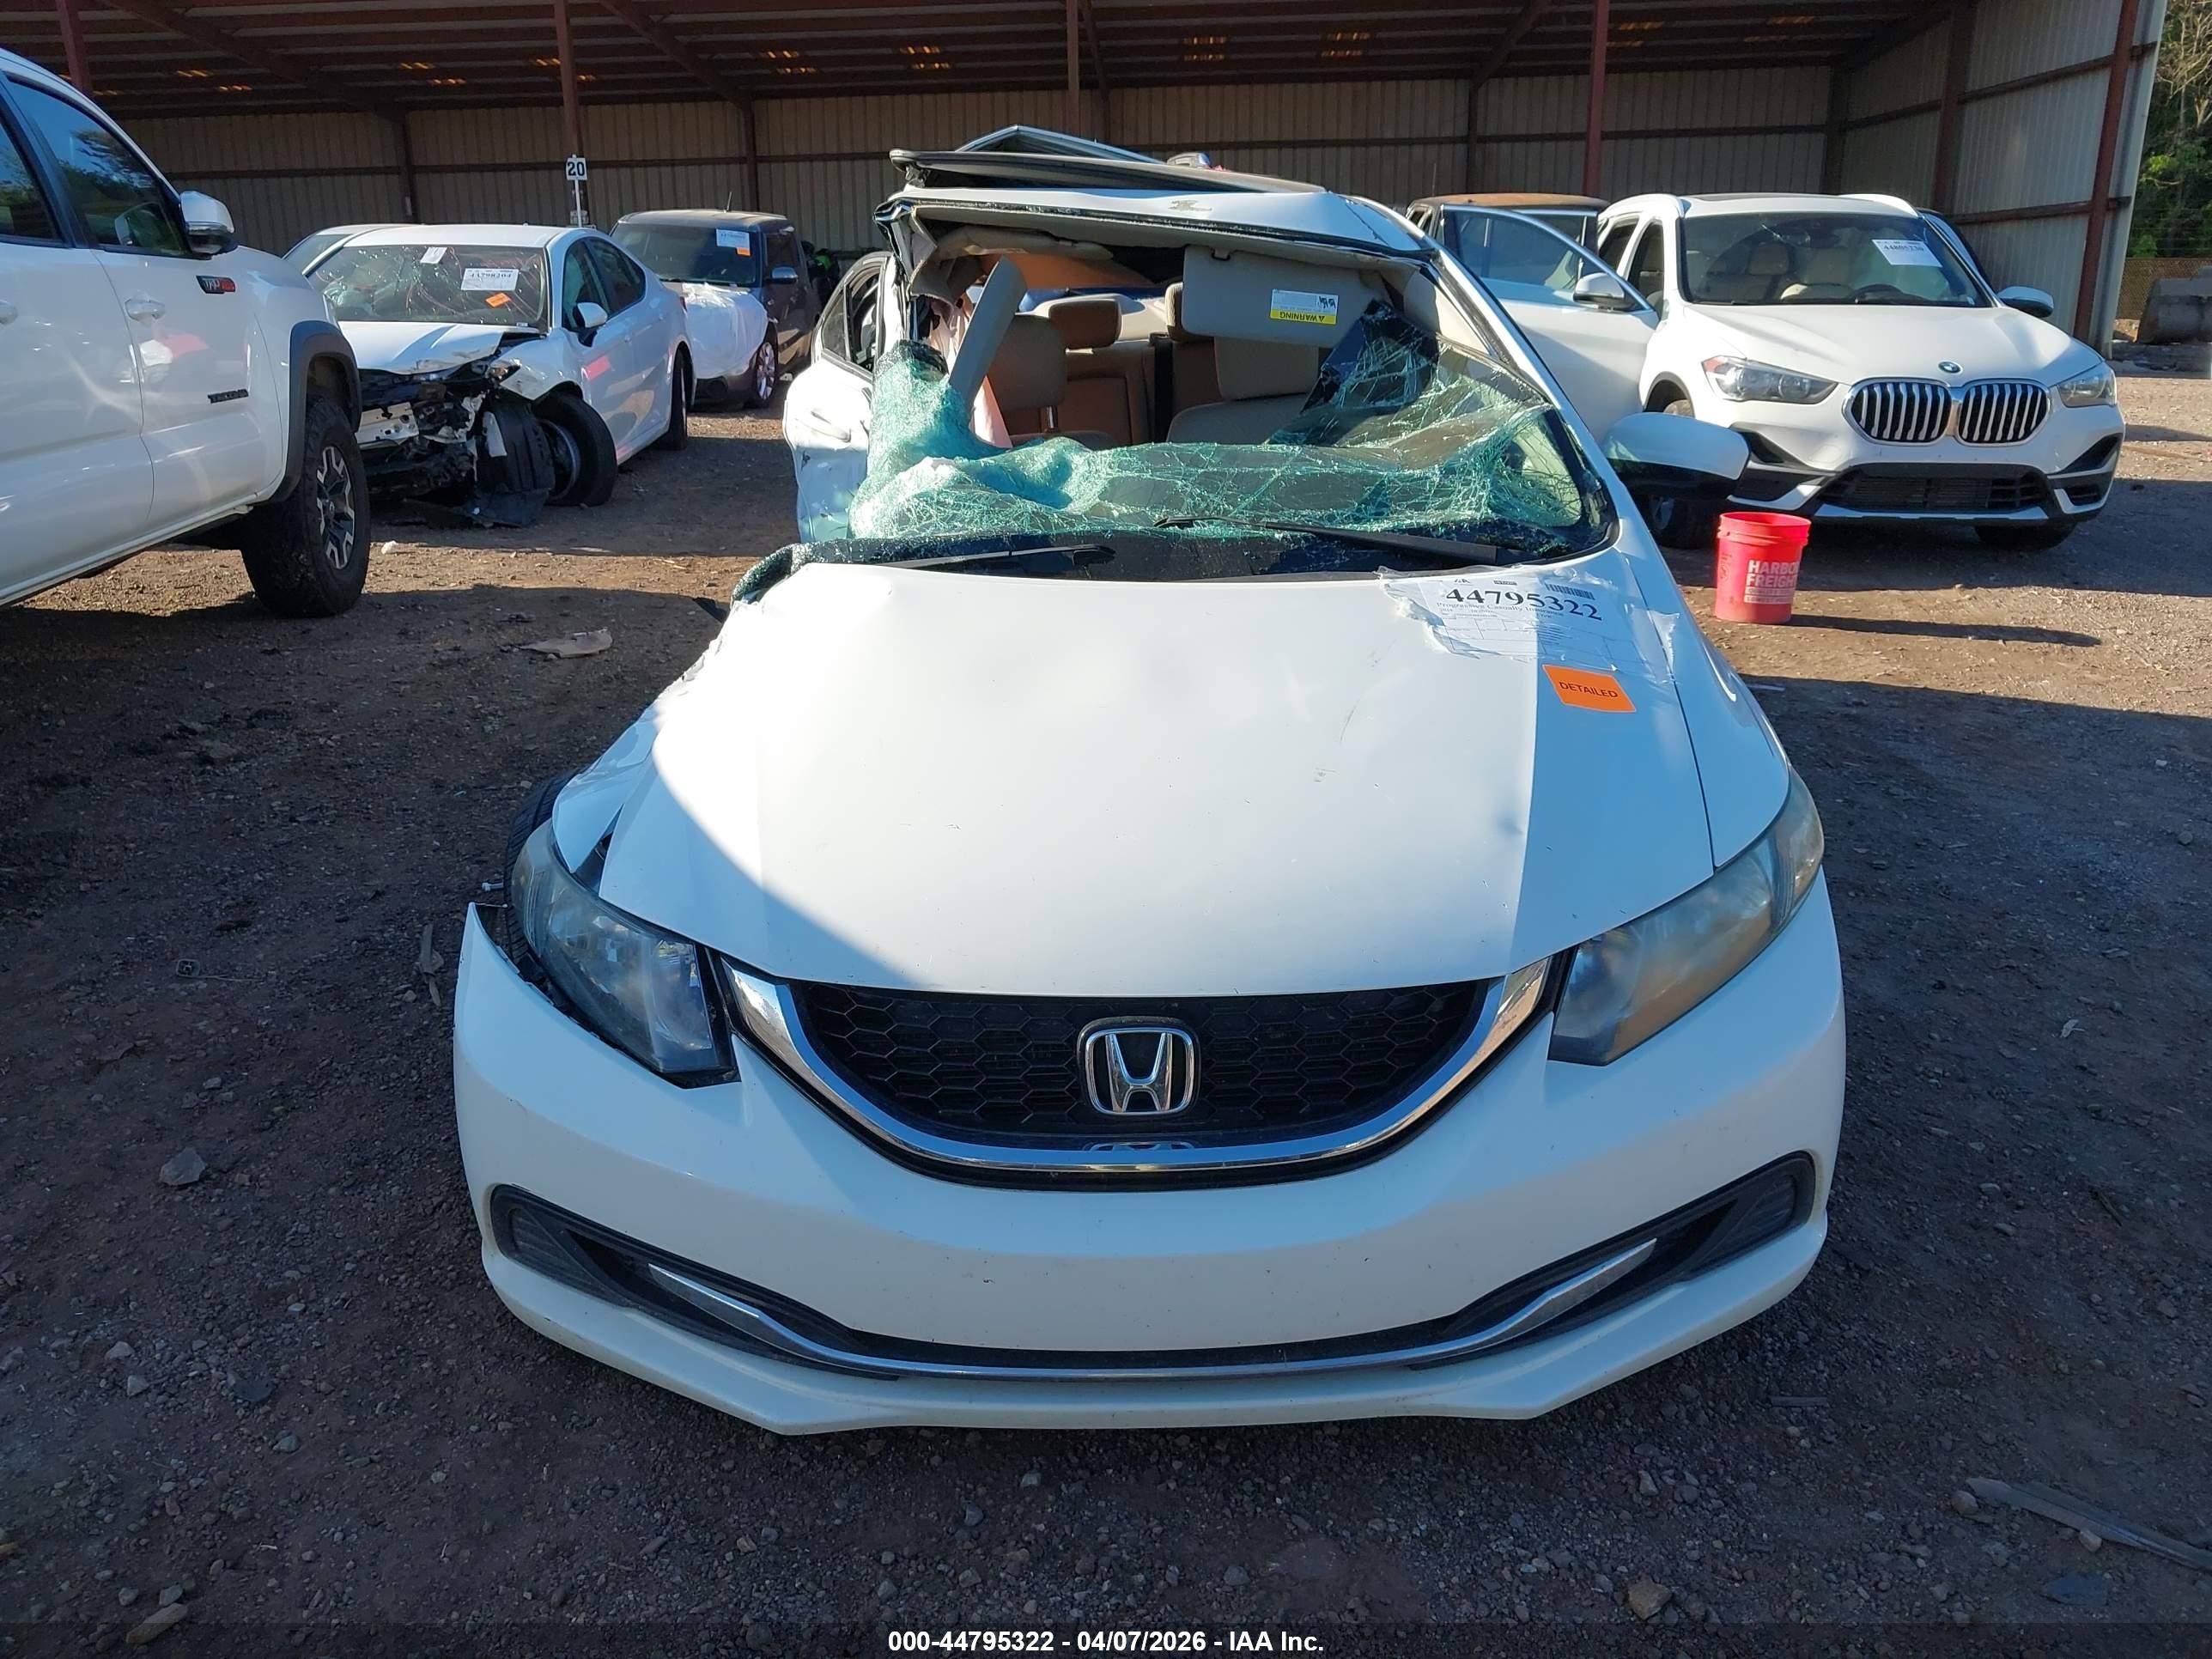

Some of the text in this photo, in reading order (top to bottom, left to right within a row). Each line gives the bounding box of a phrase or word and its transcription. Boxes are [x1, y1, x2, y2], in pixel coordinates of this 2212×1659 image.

[568, 161, 585, 177] 20
[1279, 311, 1319, 321] WARNING
[1446, 588, 1602, 622] 44795322
[1559, 681, 1619, 699] DETAILED
